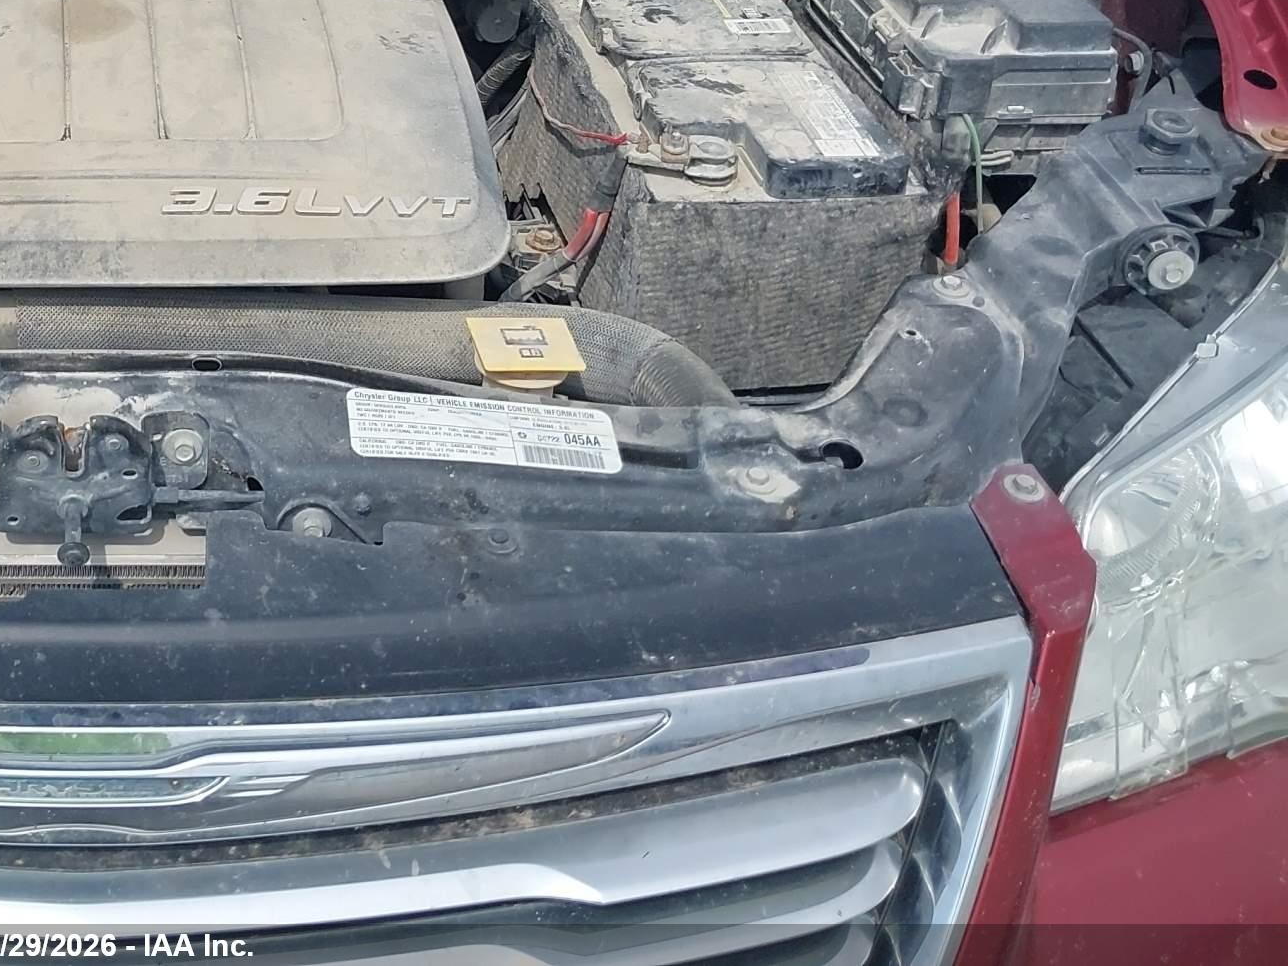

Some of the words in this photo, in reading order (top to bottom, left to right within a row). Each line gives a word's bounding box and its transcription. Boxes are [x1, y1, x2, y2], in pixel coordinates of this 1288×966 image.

[354, 391, 385, 401] Chrysler
[387, 393, 411, 403] Group
[413, 396, 428, 404] LLC
[437, 398, 468, 408] VEHICLE
[470, 401, 505, 411] EMISSION
[507, 405, 541, 414] CONTROL
[543, 409, 595, 419] INFORMATION
[565, 433, 601, 447] 045AA
